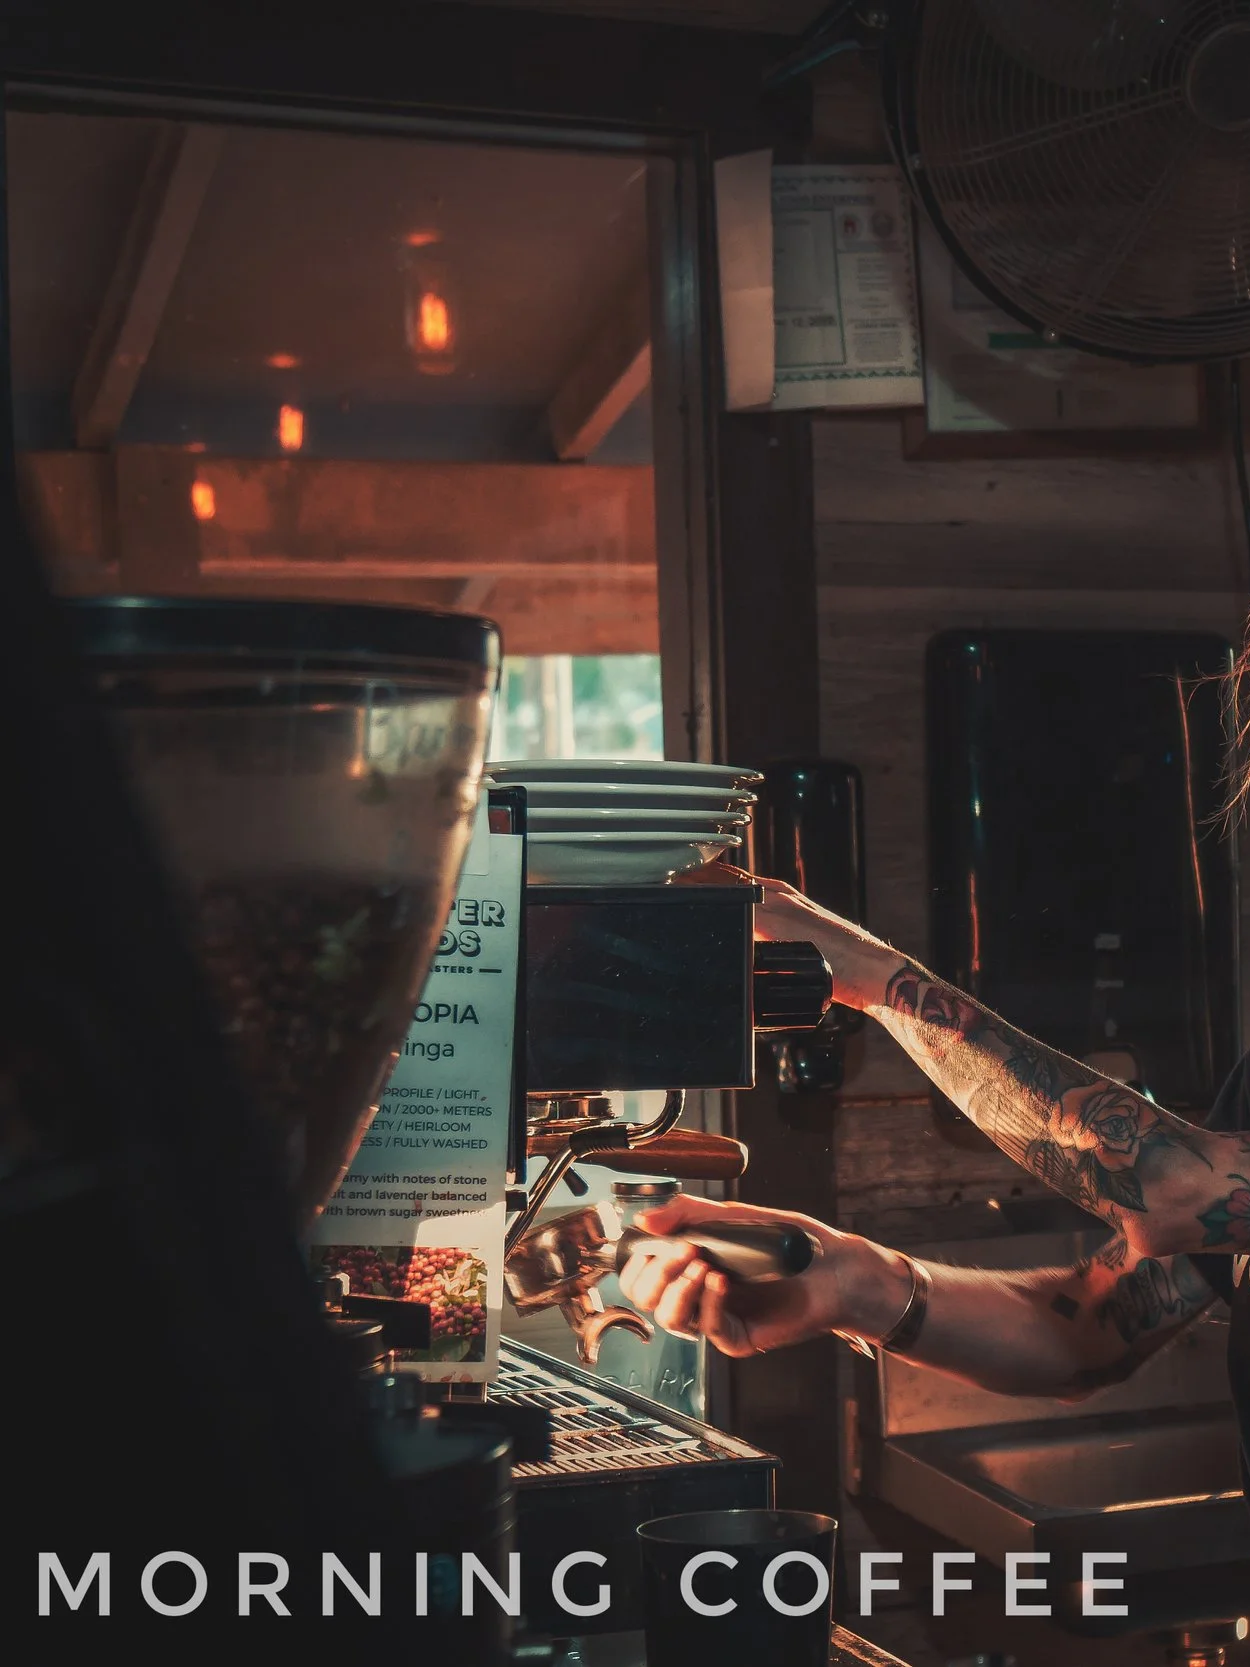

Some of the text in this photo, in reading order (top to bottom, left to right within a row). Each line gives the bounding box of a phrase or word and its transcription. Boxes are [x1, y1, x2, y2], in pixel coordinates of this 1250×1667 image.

[383, 1087, 434, 1099] PROFILE
[444, 1089, 480, 1100] LIGHT
[402, 1105, 440, 1115] 2000+
[443, 1106, 492, 1117] METERS
[405, 1121, 471, 1132] HEIRLOOM
[393, 1137, 431, 1148] FULLY
[431, 1139, 488, 1150] WASHED
[371, 1173, 399, 1184] with
[402, 1174, 436, 1184] notes
[439, 1174, 453, 1184] of
[453, 1175, 487, 1185] stone
[349, 1189, 372, 1199] and
[376, 1190, 428, 1201] lavender
[431, 1191, 487, 1202] balanced
[346, 1205, 386, 1217] brown
[389, 1208, 424, 1219] sugar
